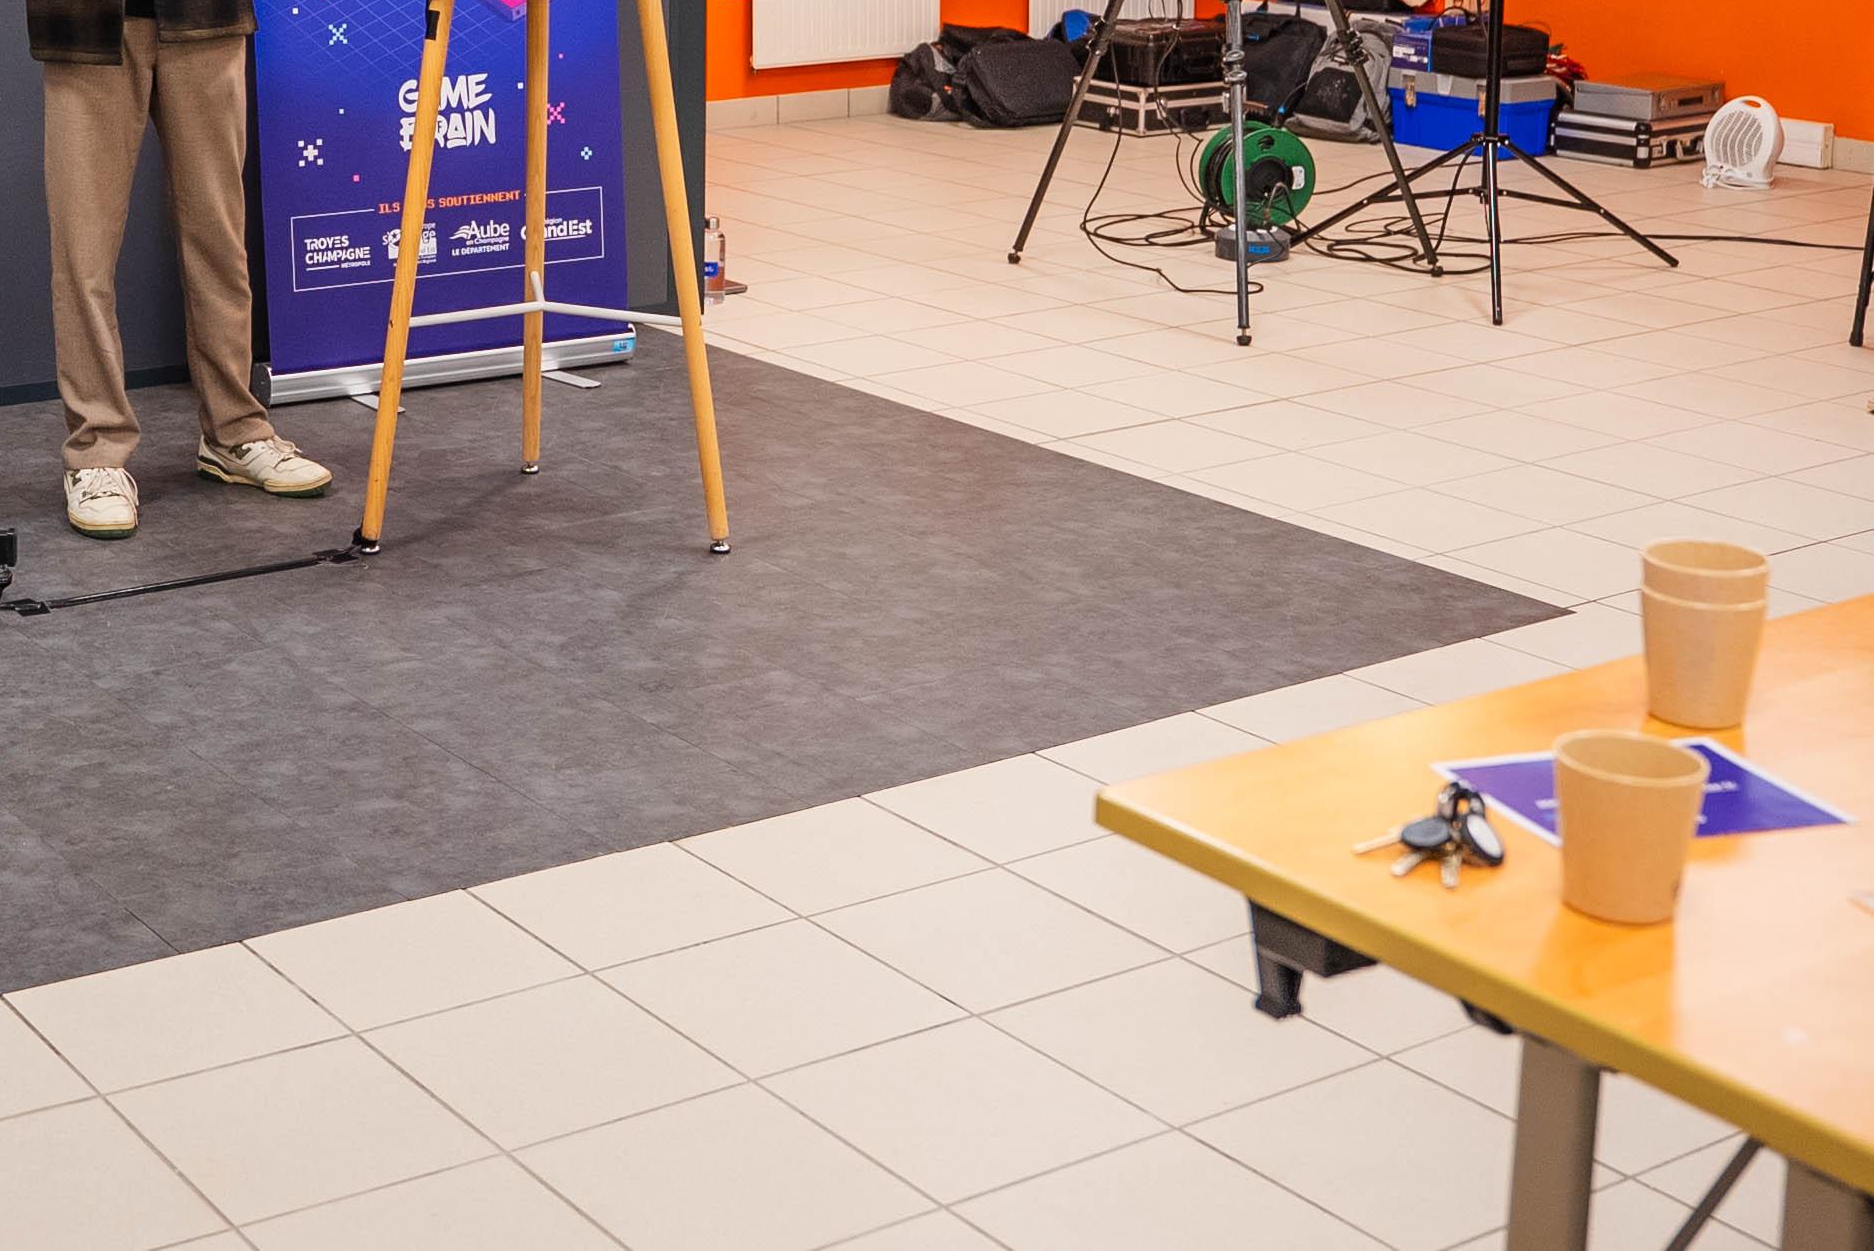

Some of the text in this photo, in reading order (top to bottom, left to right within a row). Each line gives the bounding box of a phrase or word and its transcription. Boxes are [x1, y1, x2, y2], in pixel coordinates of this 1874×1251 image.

[398, 72, 493, 113] GME
[378, 202, 401, 215] ILS
[438, 189, 521, 209] SOUTIENNENT
[468, 219, 510, 240] Aube
[304, 235, 350, 251] TROYES
[451, 248, 460, 256] LE
[304, 246, 372, 265] CHAMPAGNE
